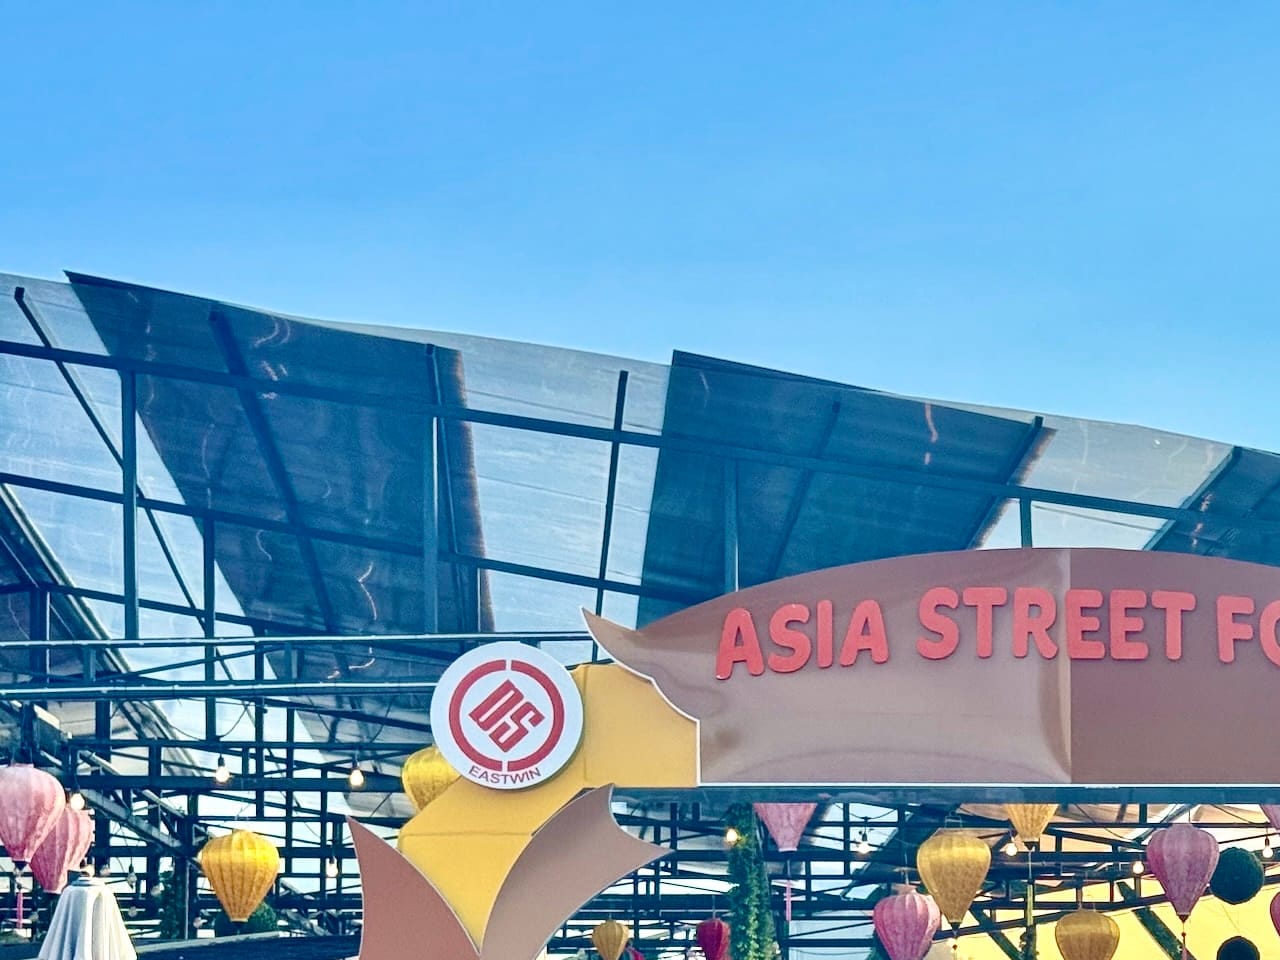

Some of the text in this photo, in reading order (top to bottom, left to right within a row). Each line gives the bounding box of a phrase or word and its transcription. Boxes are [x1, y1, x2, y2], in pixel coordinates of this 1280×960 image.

[715, 599, 889, 680] ASIA
[916, 586, 1197, 661] STREET
[468, 764, 541, 785] EASTWIN
